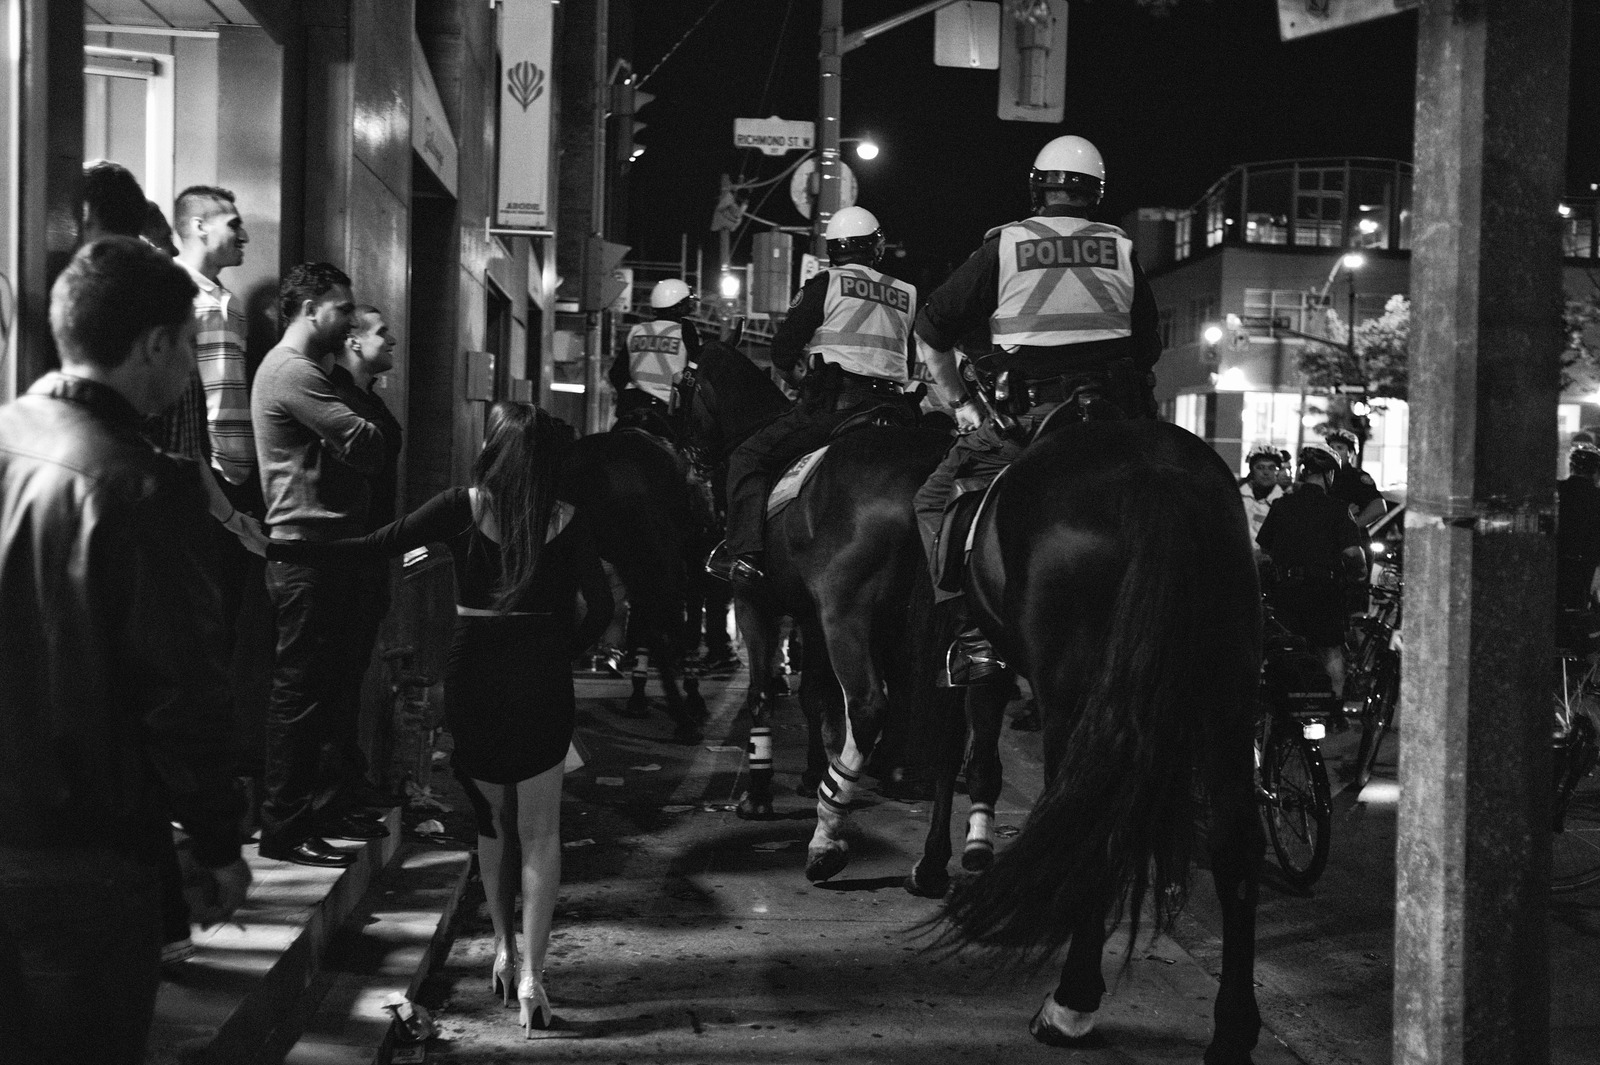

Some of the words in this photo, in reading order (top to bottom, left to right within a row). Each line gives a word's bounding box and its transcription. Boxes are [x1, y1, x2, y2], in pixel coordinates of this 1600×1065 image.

[737, 134, 786, 147] RICHMOND
[1019, 239, 1116, 267] POLICE
[842, 277, 908, 311] POLICE
[631, 337, 680, 352] POLICE
